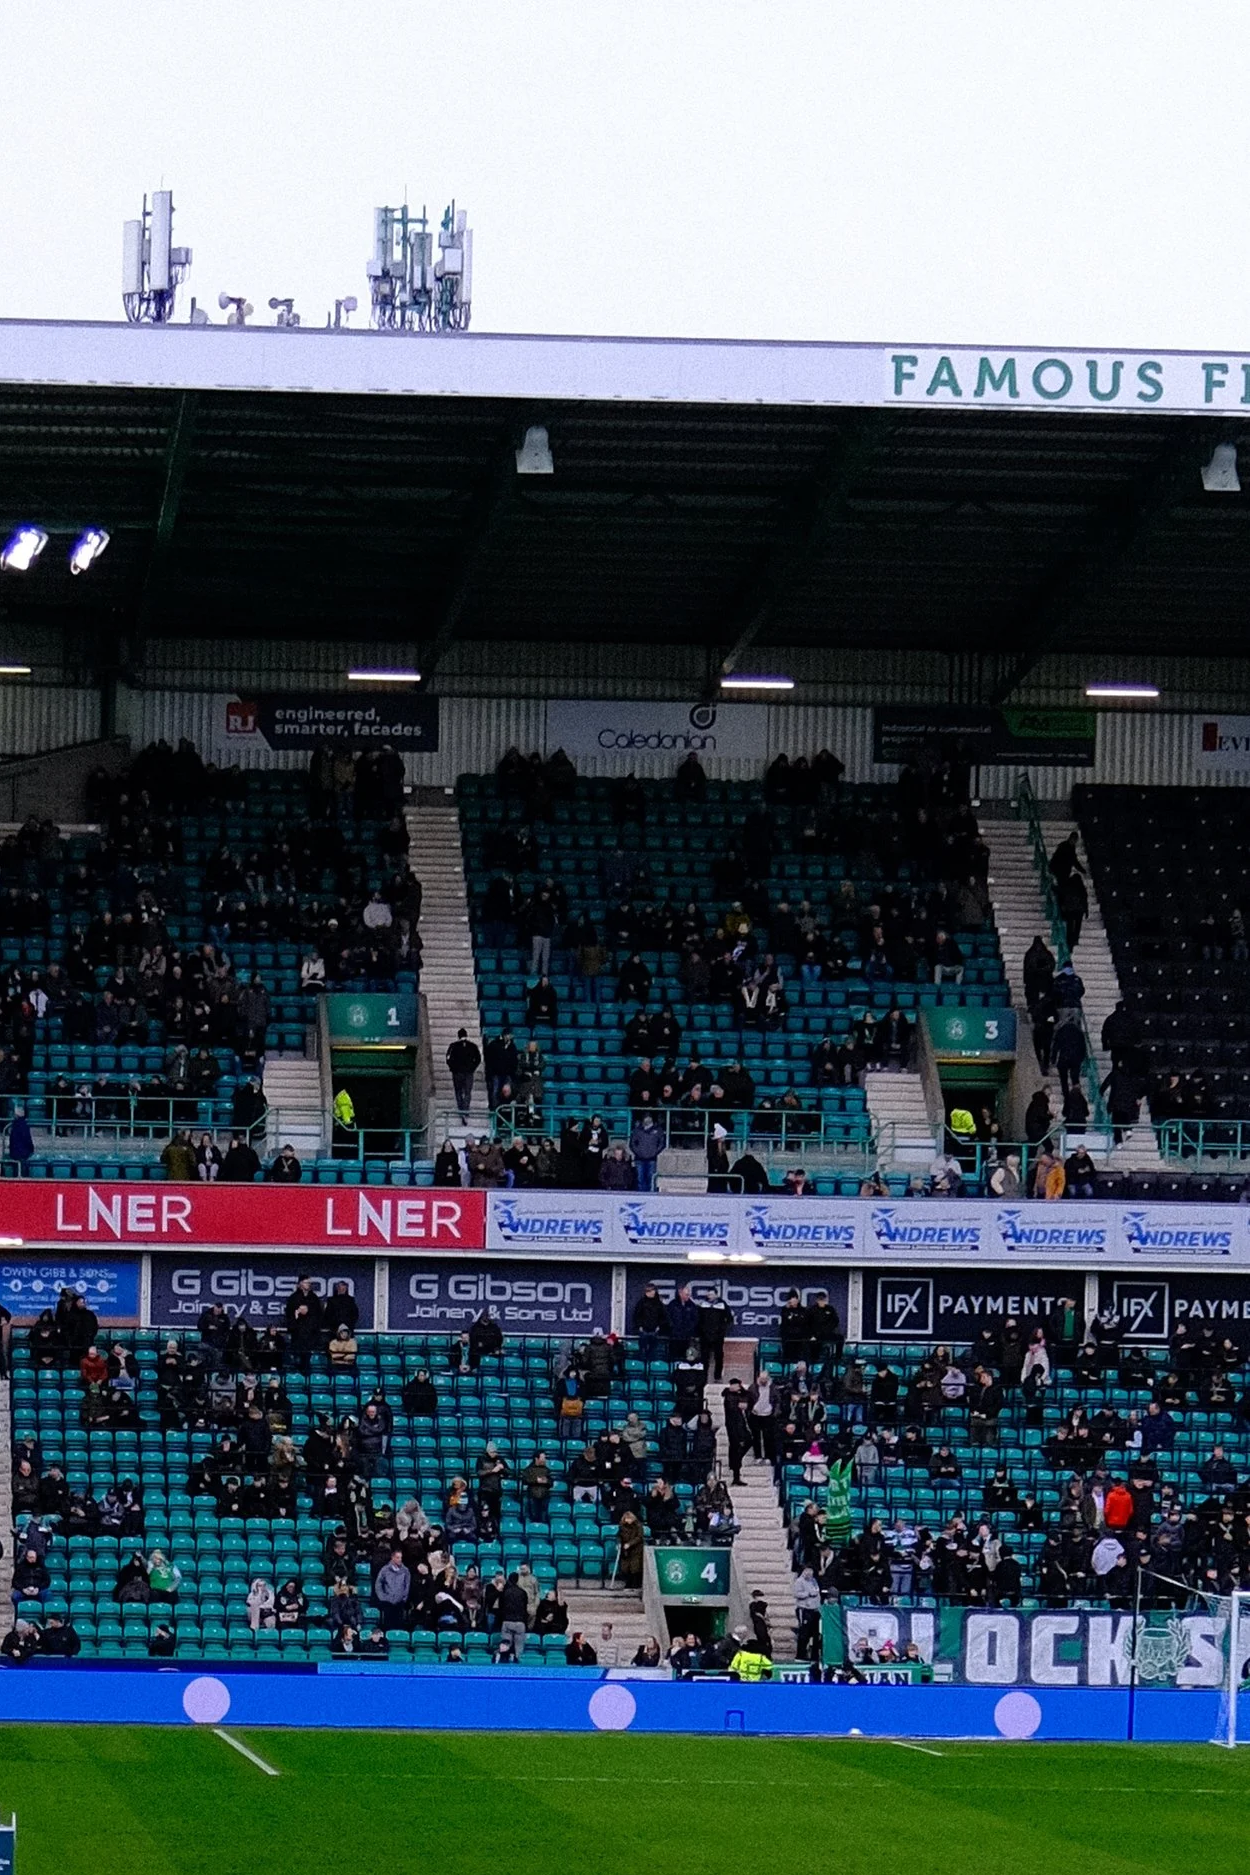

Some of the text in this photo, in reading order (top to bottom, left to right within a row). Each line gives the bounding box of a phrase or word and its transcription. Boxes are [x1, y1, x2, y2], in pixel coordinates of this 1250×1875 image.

[891, 354, 1164, 402] FAMOUS
[229, 715, 255, 731] RJ
[275, 706, 381, 722] engineered,
[275, 722, 349, 737] smarter,
[598, 728, 716, 750] Caledonian
[387, 1007, 400, 1026] 1
[985, 1021, 999, 1040] 3
[56, 1186, 192, 1239] LNER
[325, 1191, 462, 1244] LNER
[2, 1266, 37, 1277] OWEN
[40, 1267, 67, 1278] GIBB
[69, 1268, 77, 1278] &
[172, 1269, 200, 1296] G
[409, 1273, 593, 1304] G Gibson
[250, 1301, 264, 1315] &
[407, 1304, 593, 1322] Joinery & Sons Ltd
[887, 1287, 1068, 1328] IFX PAYMENT
[1123, 1291, 1158, 1332] IFX
[742, 1312, 782, 1326] Son
[701, 1562, 718, 1584] 4
